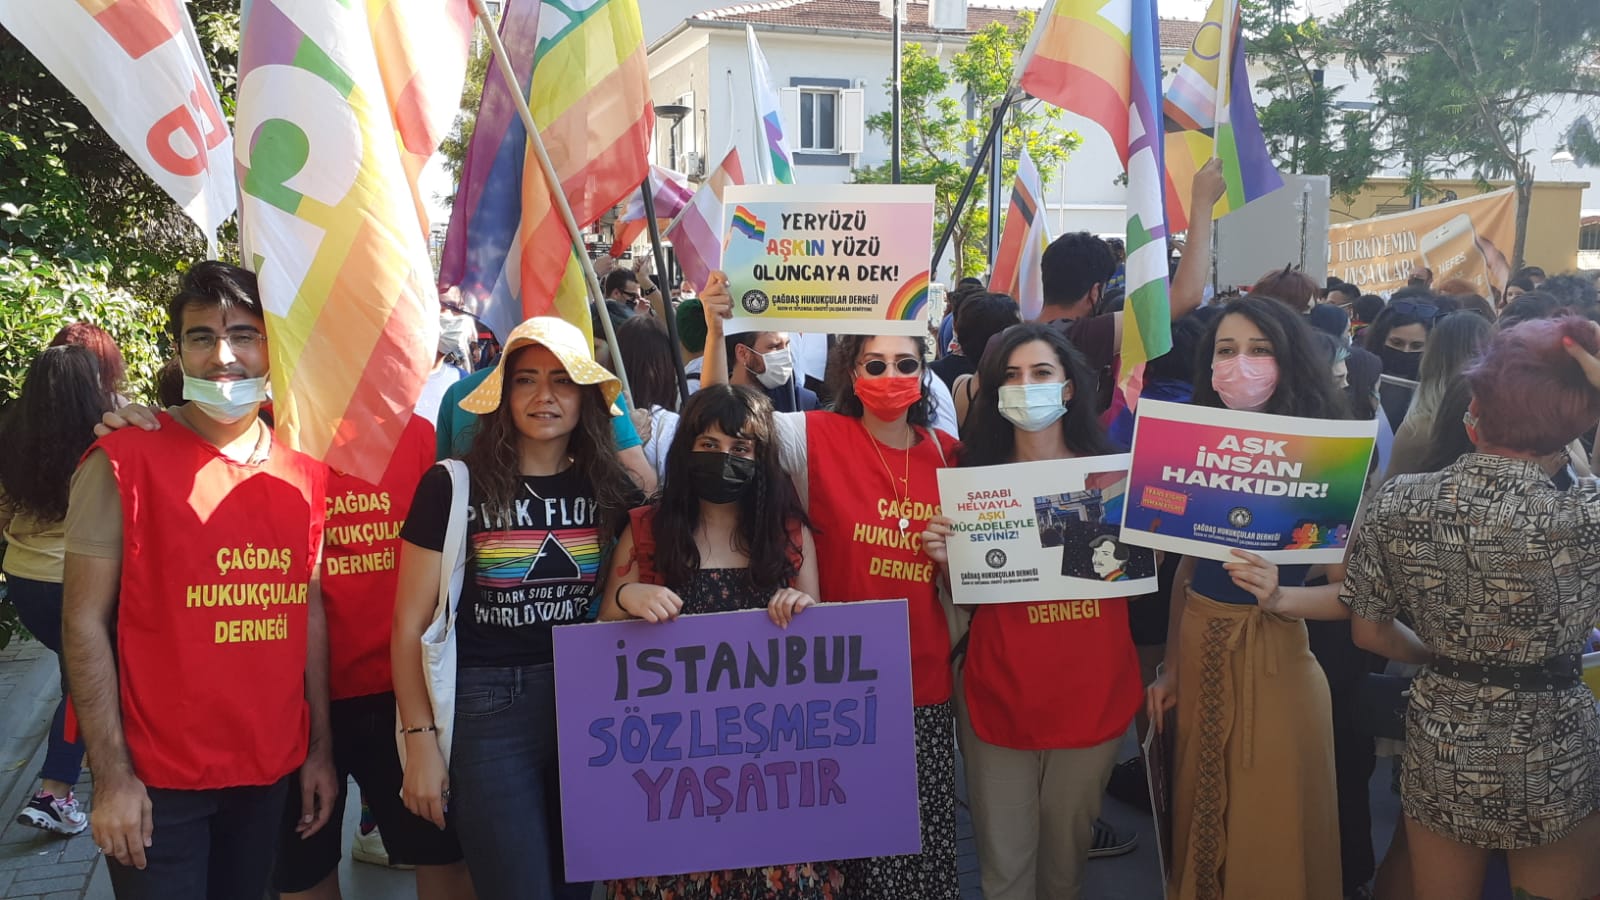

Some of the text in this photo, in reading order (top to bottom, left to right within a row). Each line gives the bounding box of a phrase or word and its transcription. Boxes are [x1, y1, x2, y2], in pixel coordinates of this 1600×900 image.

[781, 210, 867, 231] YERYÜZÜ
[766, 236, 880, 262] AŞKIN YÜZÜ
[753, 264, 899, 282] OLUNCAYA DEK!
[772, 293, 800, 307] ÇAĞDAŞ
[801, 295, 847, 307] HUKUKÇULAR
[849, 294, 879, 304] DERNEĞİ
[1217, 434, 1288, 458] AŞK
[1196, 446, 1303, 478] İNSAN
[967, 488, 1011, 502] ŞARABI
[1162, 466, 1329, 498] HAKKIDIR!
[325, 490, 391, 520] ÇAĞDAŞ
[544, 497, 598, 527] FLOY
[978, 511, 1006, 522] AŞKI
[326, 520, 405, 546] KUKÇULA
[949, 518, 1035, 532] MÜCADELEYLE
[970, 529, 1020, 542] SEVİNİZ!
[216, 542, 292, 576] ÇAĞDAŞ
[326, 546, 395, 576] DERNEĞİ
[869, 557, 934, 583] DERNEĞ
[186, 583, 308, 611] HUKUKÇULAR
[497, 589, 526, 603] DARK
[528, 586, 554, 599] SIDE
[556, 585, 568, 598] OF
[474, 603, 535, 628] WORLD
[534, 599, 574, 622] TOUR
[215, 612, 288, 643] DERNEĞİ
[614, 635, 878, 701] İSTANBUL
[588, 686, 878, 767] SÖZLEŞMESİ
[632, 758, 847, 823] YAŞATIR
